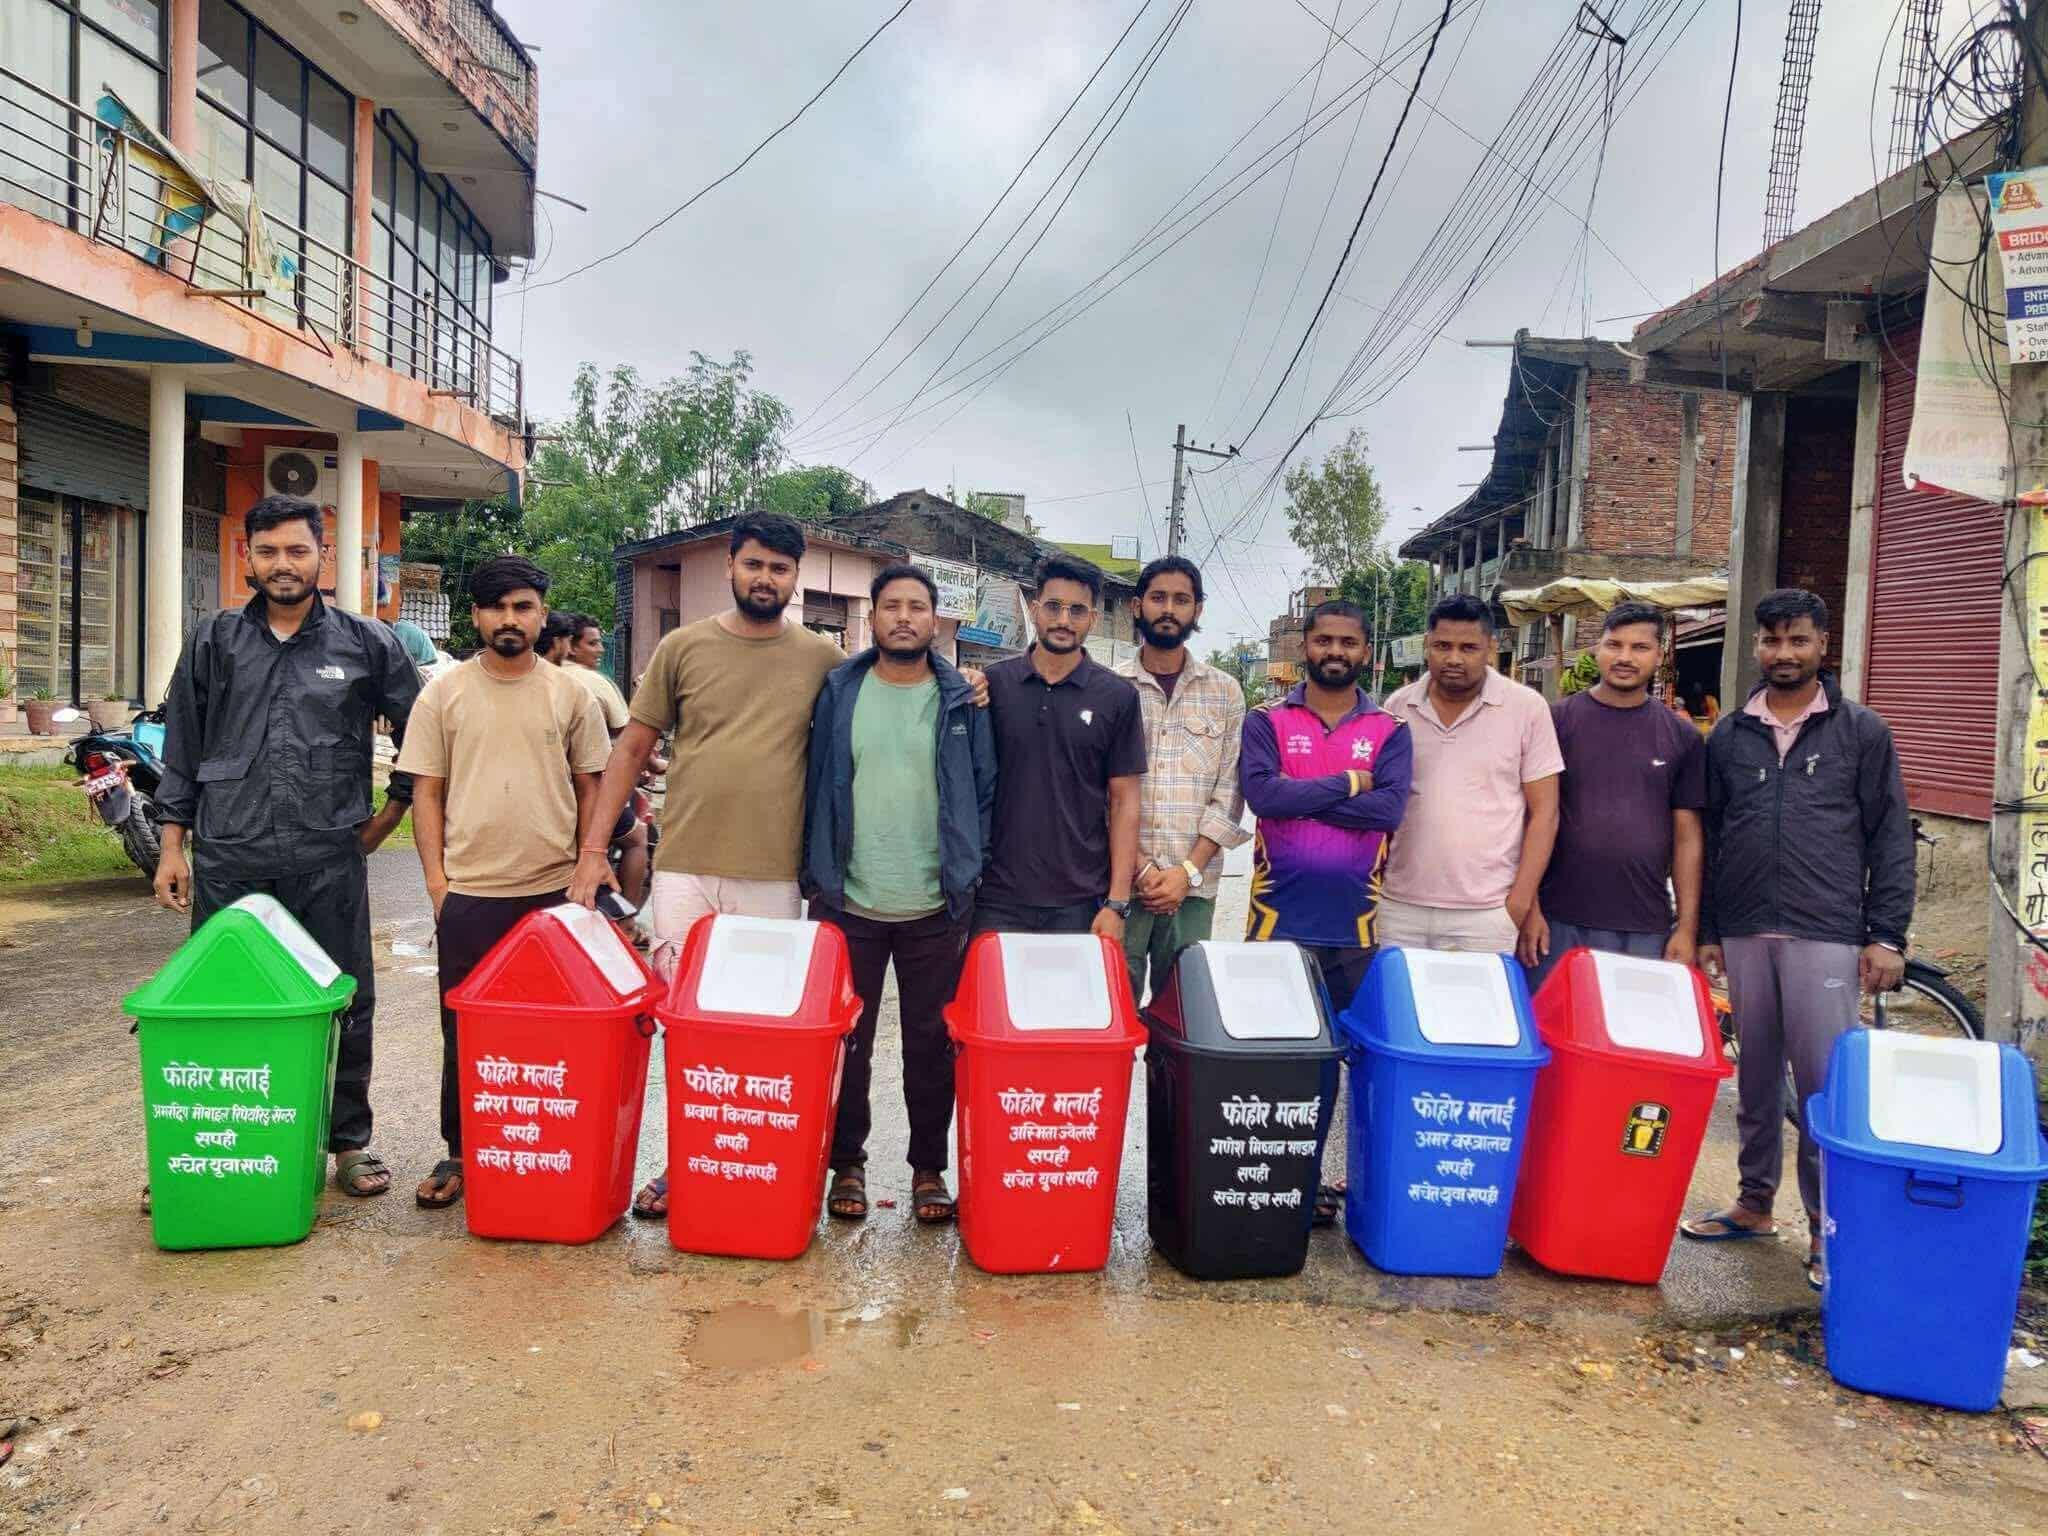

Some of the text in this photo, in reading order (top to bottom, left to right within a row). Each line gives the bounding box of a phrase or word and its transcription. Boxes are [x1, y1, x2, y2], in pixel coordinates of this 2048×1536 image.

[162, 1062, 272, 1099] फोहोर मलाई
[475, 1054, 568, 1096] फोहोर मलाई
[683, 1064, 793, 1108] फोहोर मलाई
[511, 1096, 541, 1115] पान
[542, 1098, 578, 1118] पसल
[998, 1088, 1102, 1120] फोहोर मलाई
[1221, 1095, 1320, 1129] फोहोर मलाई
[1412, 1092, 1516, 1132] फोहोर मलाई
[767, 1112, 800, 1130] पसल
[195, 1129, 238, 1149] सपही
[503, 1122, 540, 1144] सपही
[715, 1133, 749, 1152] सपही
[168, 1154, 208, 1174] सचेत
[477, 1146, 511, 1170] सचेत
[688, 1155, 720, 1175] सचेत
[1027, 1145, 1070, 1167] सपही
[1003, 1170, 1035, 1188] सचेत
[1237, 1163, 1270, 1183] सपही
[1437, 1158, 1474, 1180] सपही
[1213, 1189, 1246, 1205] सचेत
[1408, 1181, 1440, 1201] सचेत
